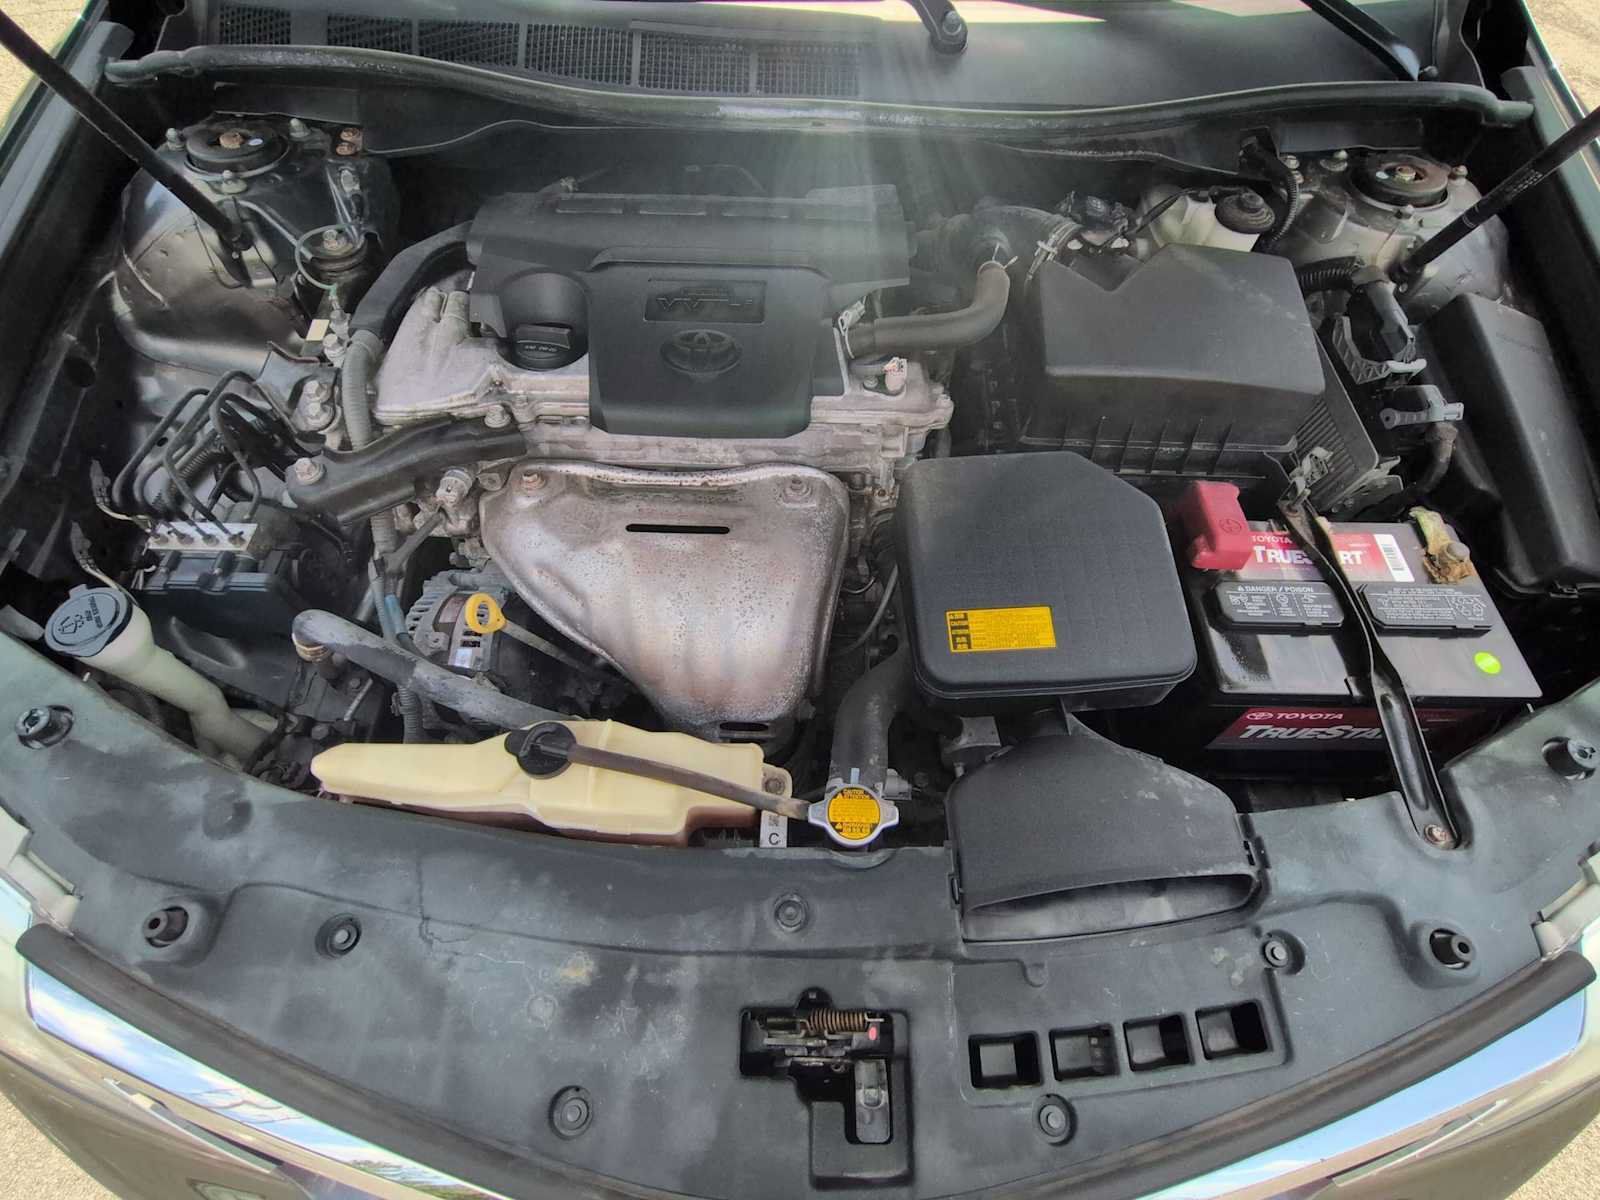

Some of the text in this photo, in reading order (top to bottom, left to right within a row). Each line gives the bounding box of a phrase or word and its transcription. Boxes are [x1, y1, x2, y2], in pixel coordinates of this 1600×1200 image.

[1251, 535, 1293, 544] TOYOTA
[1245, 585, 1277, 593] DANGER
[1284, 585, 1314, 593] POISON
[1276, 712, 1344, 720] TOYOTA
[768, 832, 780, 846] C
